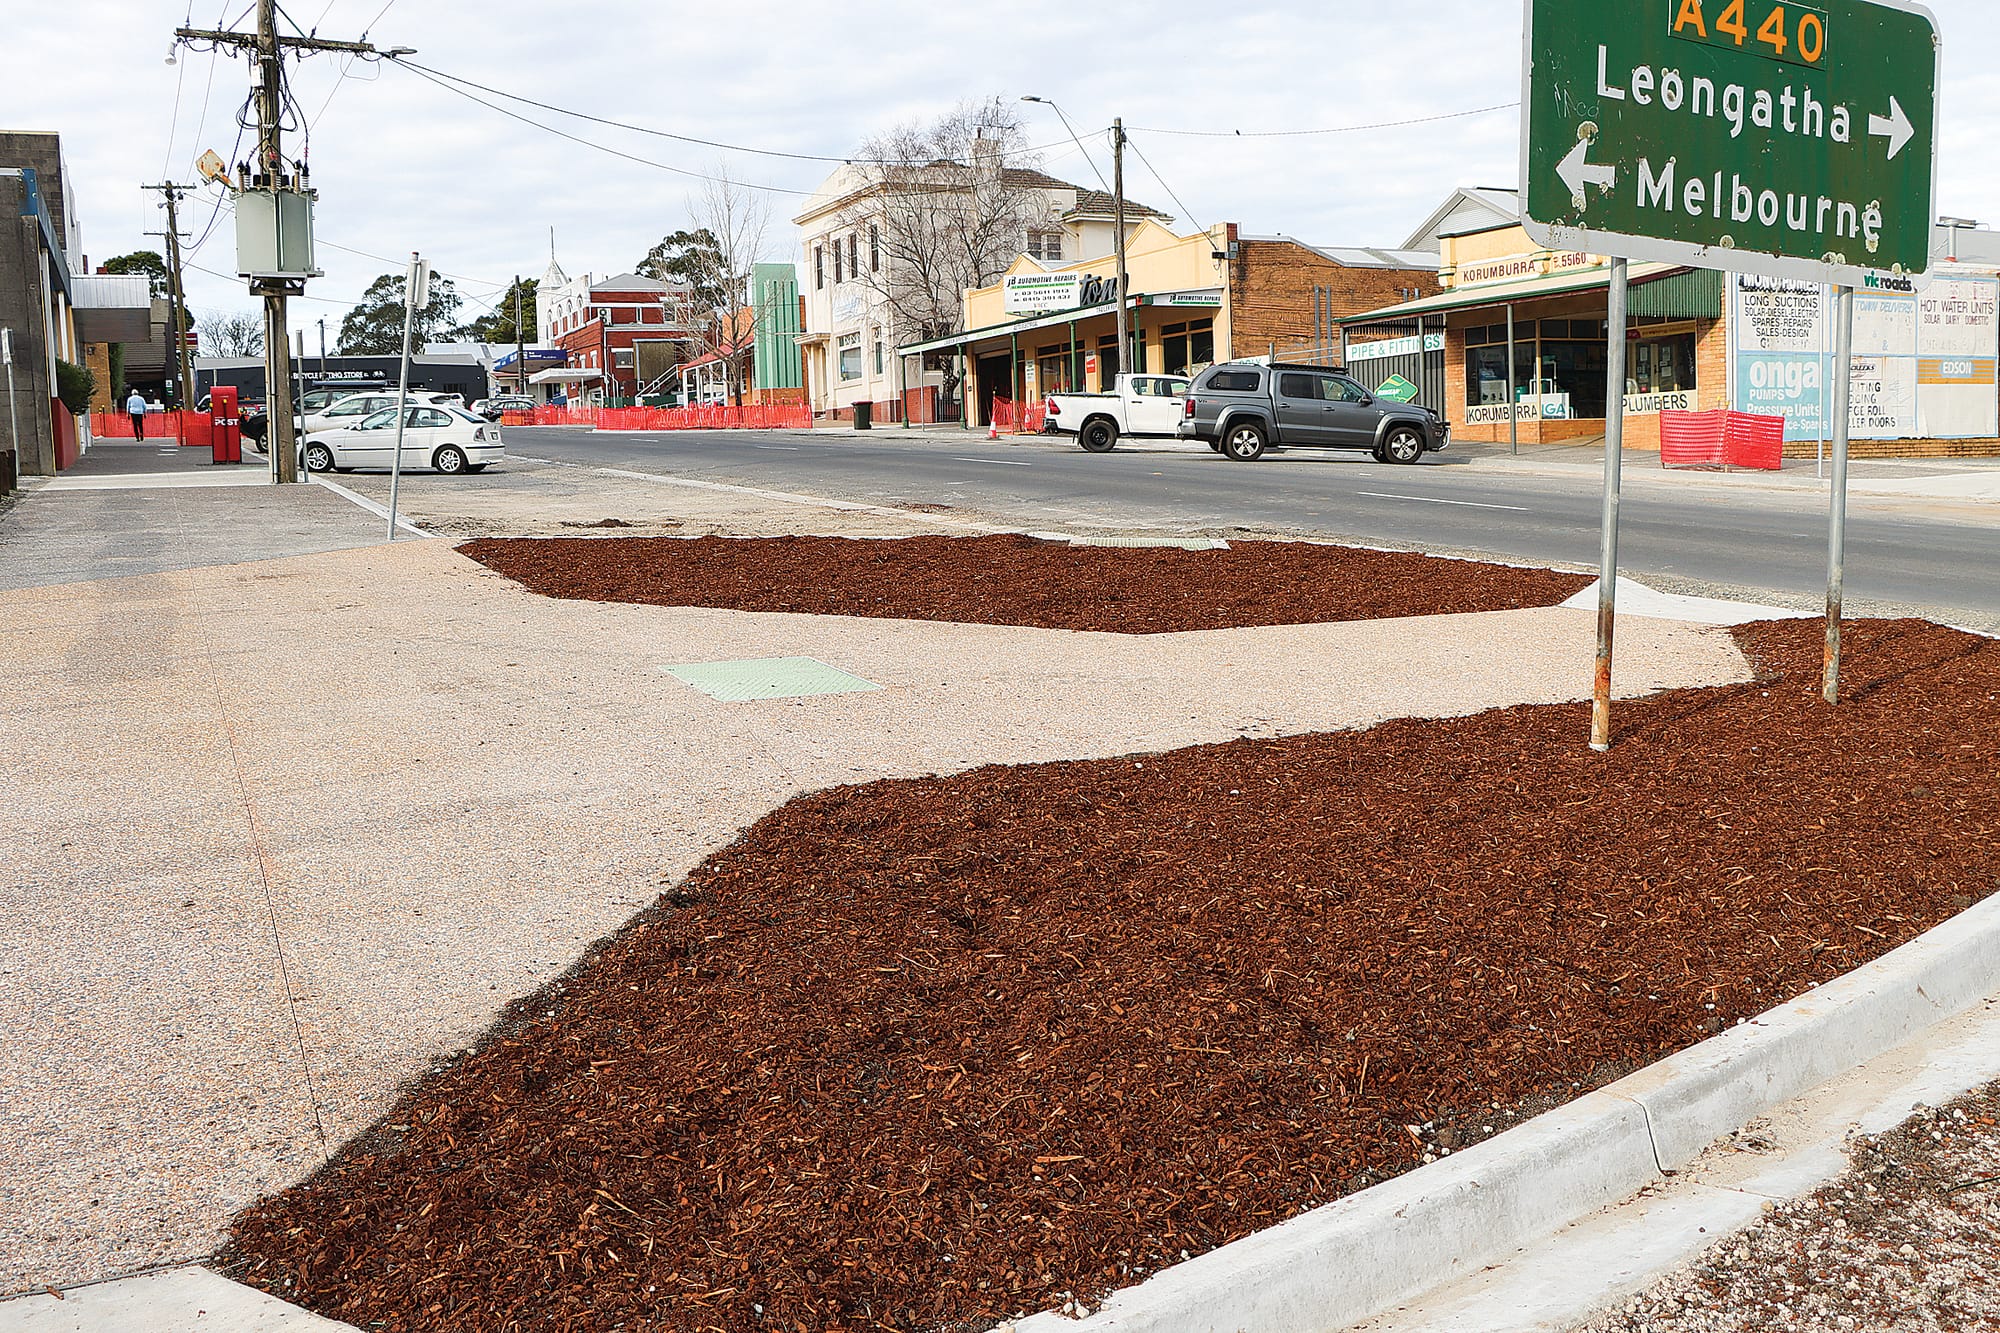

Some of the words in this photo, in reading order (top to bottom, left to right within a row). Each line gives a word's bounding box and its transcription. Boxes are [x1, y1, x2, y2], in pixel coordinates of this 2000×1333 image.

[1673, 0, 1824, 63] A440
[1597, 44, 1850, 143] Leongatha
[1637, 157, 1882, 242] Melbourne
[1463, 260, 1536, 282] KORUMBURRA
[1561, 252, 1587, 267] 55160
[1744, 295, 1770, 306] LONG
[1774, 296, 1818, 308] SUCTIONS
[1920, 300, 1938, 313] HOT
[1941, 300, 1969, 313] WATER
[1971, 301, 1994, 315] UNITS
[1351, 344, 1375, 359] PIPE
[1378, 342, 1386, 355] &
[1943, 361, 1972, 375] EDSON
[1749, 361, 1820, 398] onga
[1622, 393, 1688, 412] PLUMBERS
[1749, 388, 1785, 401] PUMPS
[1468, 405, 1538, 422] KORUMBRRA
[1747, 403, 1793, 417] Pressure
[1795, 403, 1820, 417] Units
[214, 418, 239, 426] POST
[1869, 417, 1896, 428] DOORS
